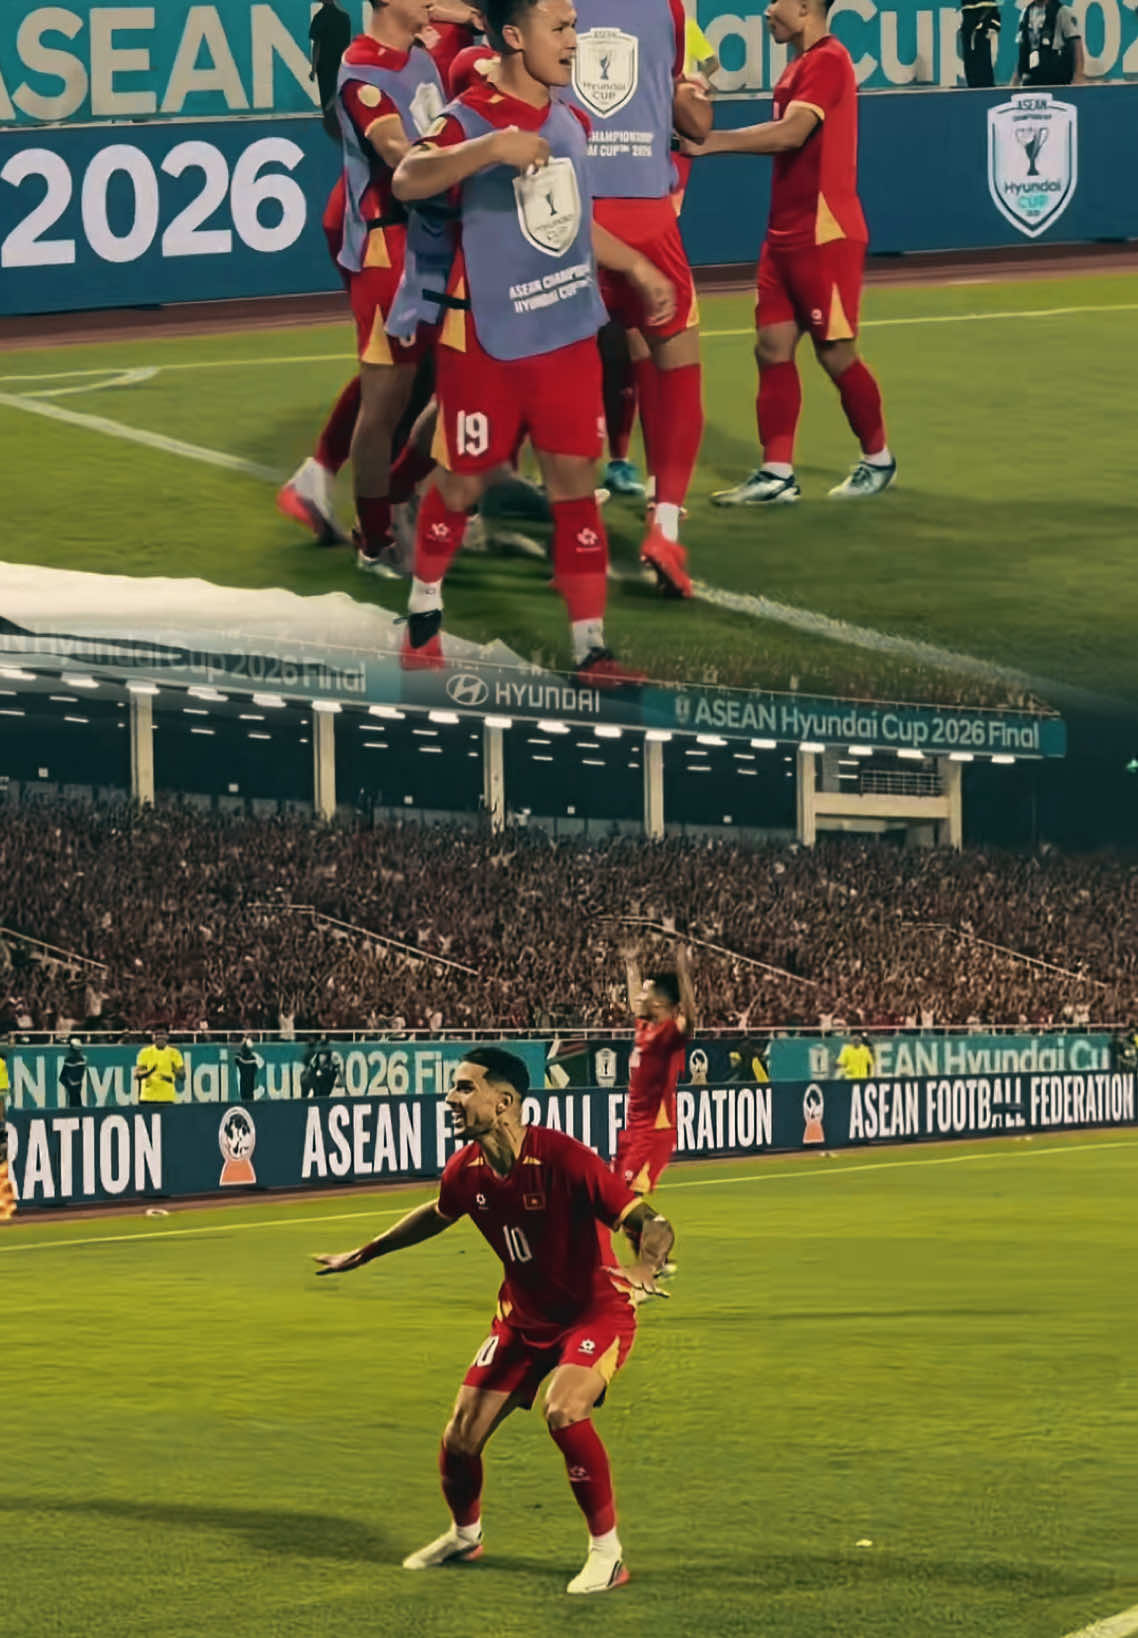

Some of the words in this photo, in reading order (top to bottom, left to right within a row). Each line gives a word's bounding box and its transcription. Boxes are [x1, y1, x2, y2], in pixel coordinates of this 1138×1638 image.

[0, 136, 307, 268] 2026
[1004, 180, 1061, 196] Hyundai
[456, 409, 488, 457] 19
[302, 657, 367, 693] Final
[495, 681, 600, 713] HYUNDAI
[695, 697, 777, 731] ASEAN
[781, 704, 879, 740] Hyundai
[881, 714, 929, 747] Cup
[930, 718, 986, 745] 2026
[988, 722, 1040, 749] Final
[943, 1036, 1065, 1076] Hyundai
[849, 1081, 920, 1140] ASEAN
[925, 1075, 1026, 1135] FOOTBALL
[1030, 1072, 1135, 1126] FEDERATION
[301, 1101, 423, 1177] ASEAN
[502, 1224, 533, 1263] 10
